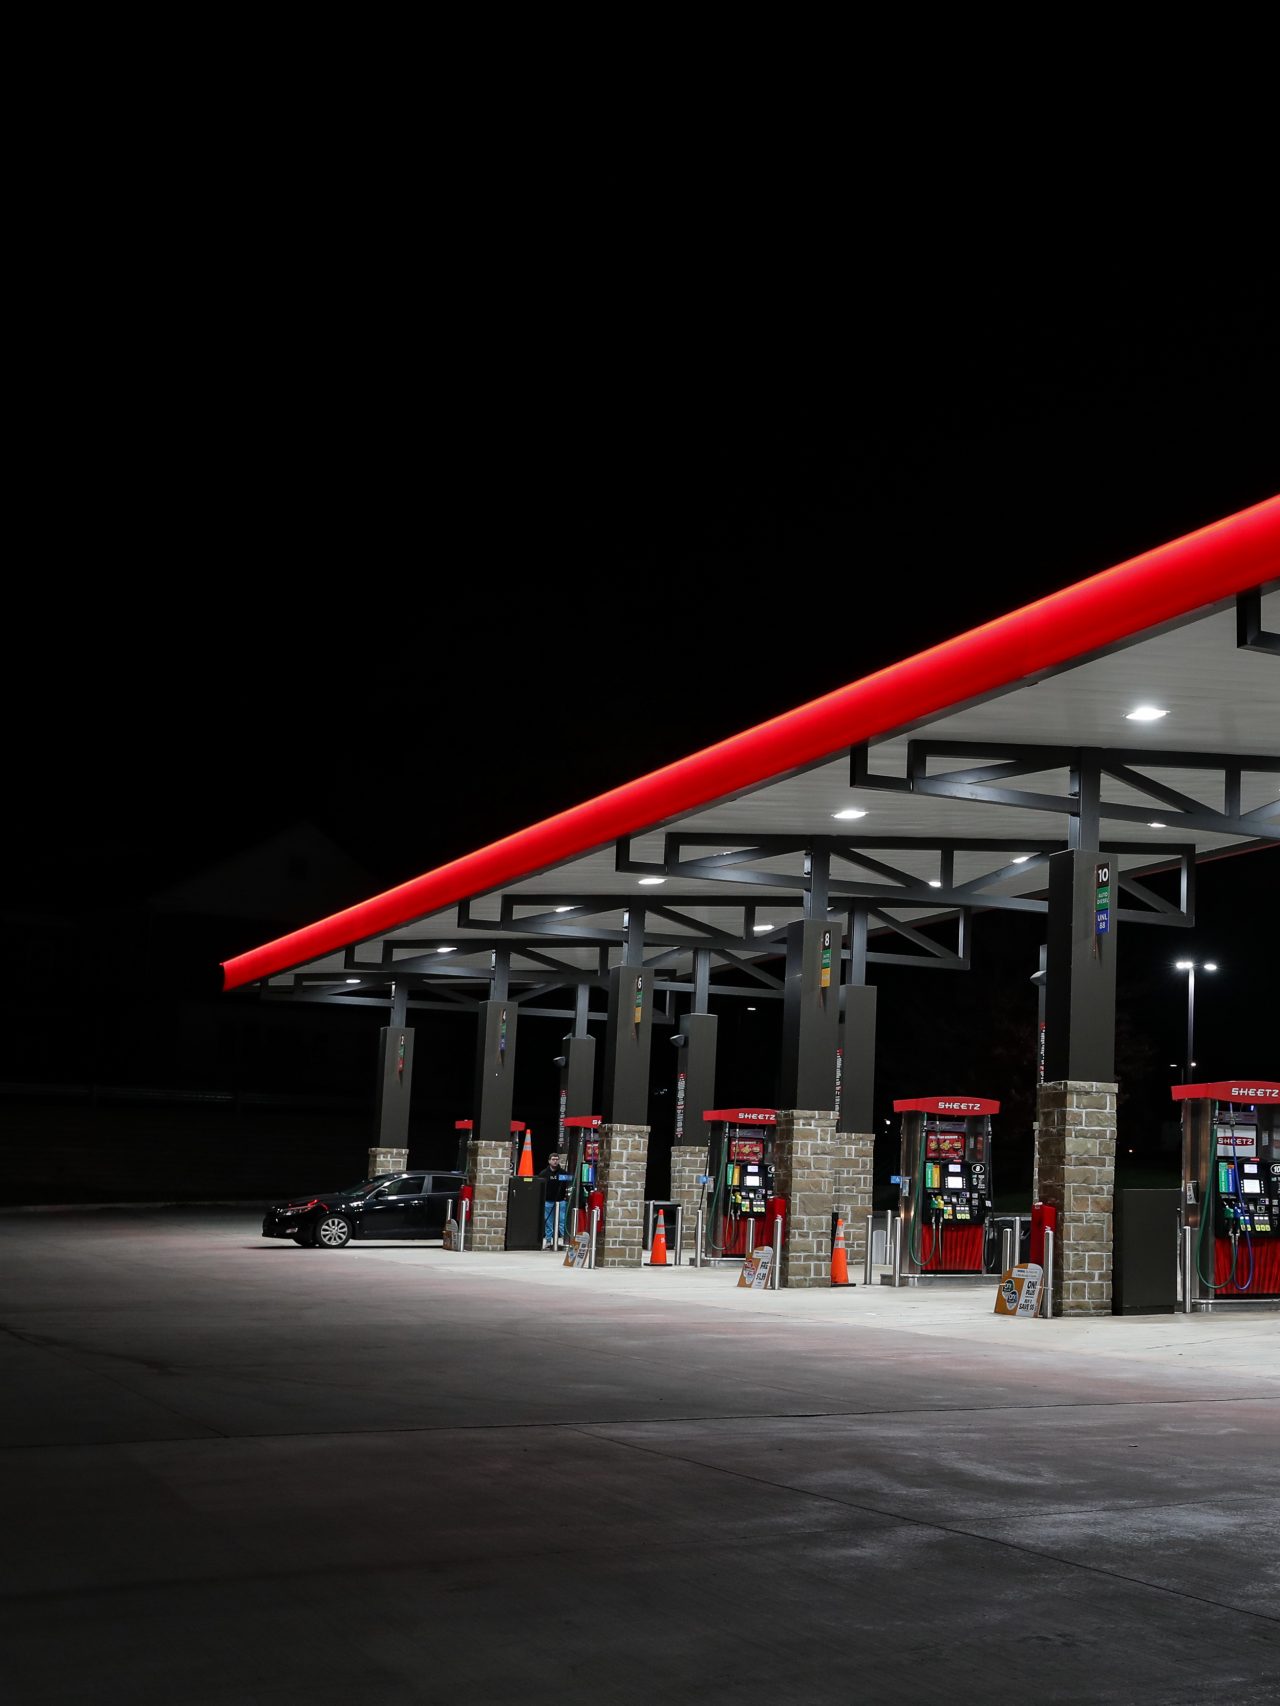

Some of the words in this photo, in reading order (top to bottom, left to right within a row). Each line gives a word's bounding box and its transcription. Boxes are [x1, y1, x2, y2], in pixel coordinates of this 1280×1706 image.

[1098, 868, 1109, 883] 10
[824, 932, 830, 947] 8
[637, 977, 642, 989] 6
[1231, 1088, 1279, 1097] SHEETZ
[938, 1101, 981, 1110] SHEETZ
[738, 1112, 776, 1120] SHEETZ
